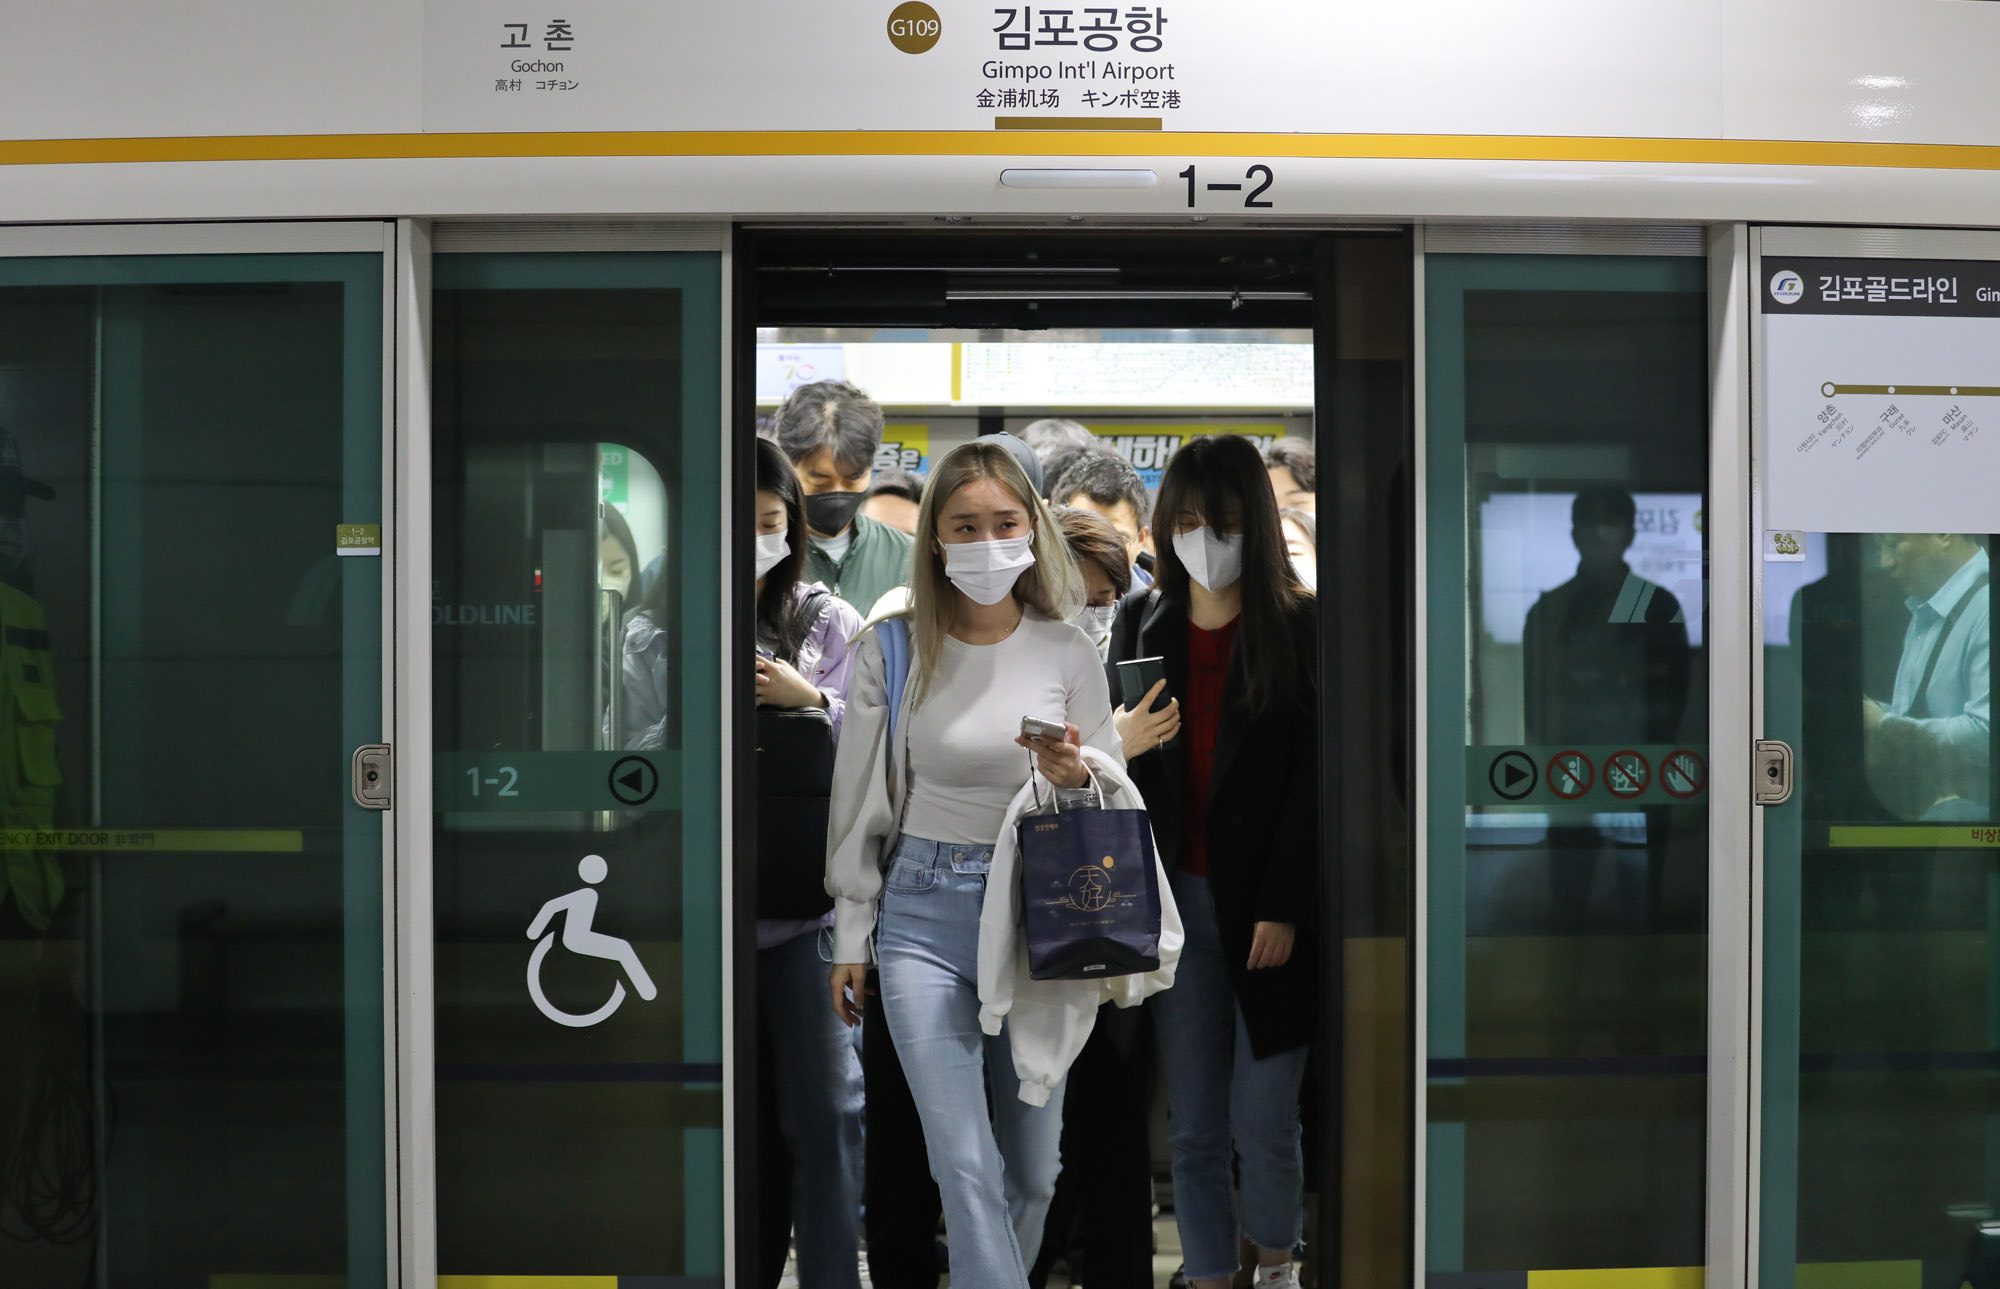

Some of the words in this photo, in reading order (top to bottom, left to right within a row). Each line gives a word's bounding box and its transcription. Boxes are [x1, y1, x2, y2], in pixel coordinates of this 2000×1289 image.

[890, 18, 940, 38] G109
[992, 5, 1168, 53] 김포공항
[510, 58, 564, 73] Gochon
[982, 60, 1053, 84] Gimpo
[1059, 60, 1096, 80] Int'l
[1102, 61, 1175, 85] Airport
[495, 78, 523, 92] 高村
[535, 79, 579, 91] コチョン
[975, 87, 1060, 109] 金浦机场
[1081, 88, 1182, 110] キンポ空港
[1819, 274, 1958, 304] 김포골드라인
[1816, 403, 1838, 424] 양촌
[1879, 403, 1900, 424] 구래
[1888, 413, 1905, 429] Gurae
[1942, 404, 1963, 425] 마산
[1950, 414, 1967, 431] Masan
[1817, 412, 1843, 437] Yangchon
[351, 527, 365, 536] 1-2
[466, 767, 519, 797] 1-2
[35, 832, 64, 846] EXIT
[68, 832, 109, 846] DOOR
[1971, 828, 2000, 843] 비상
